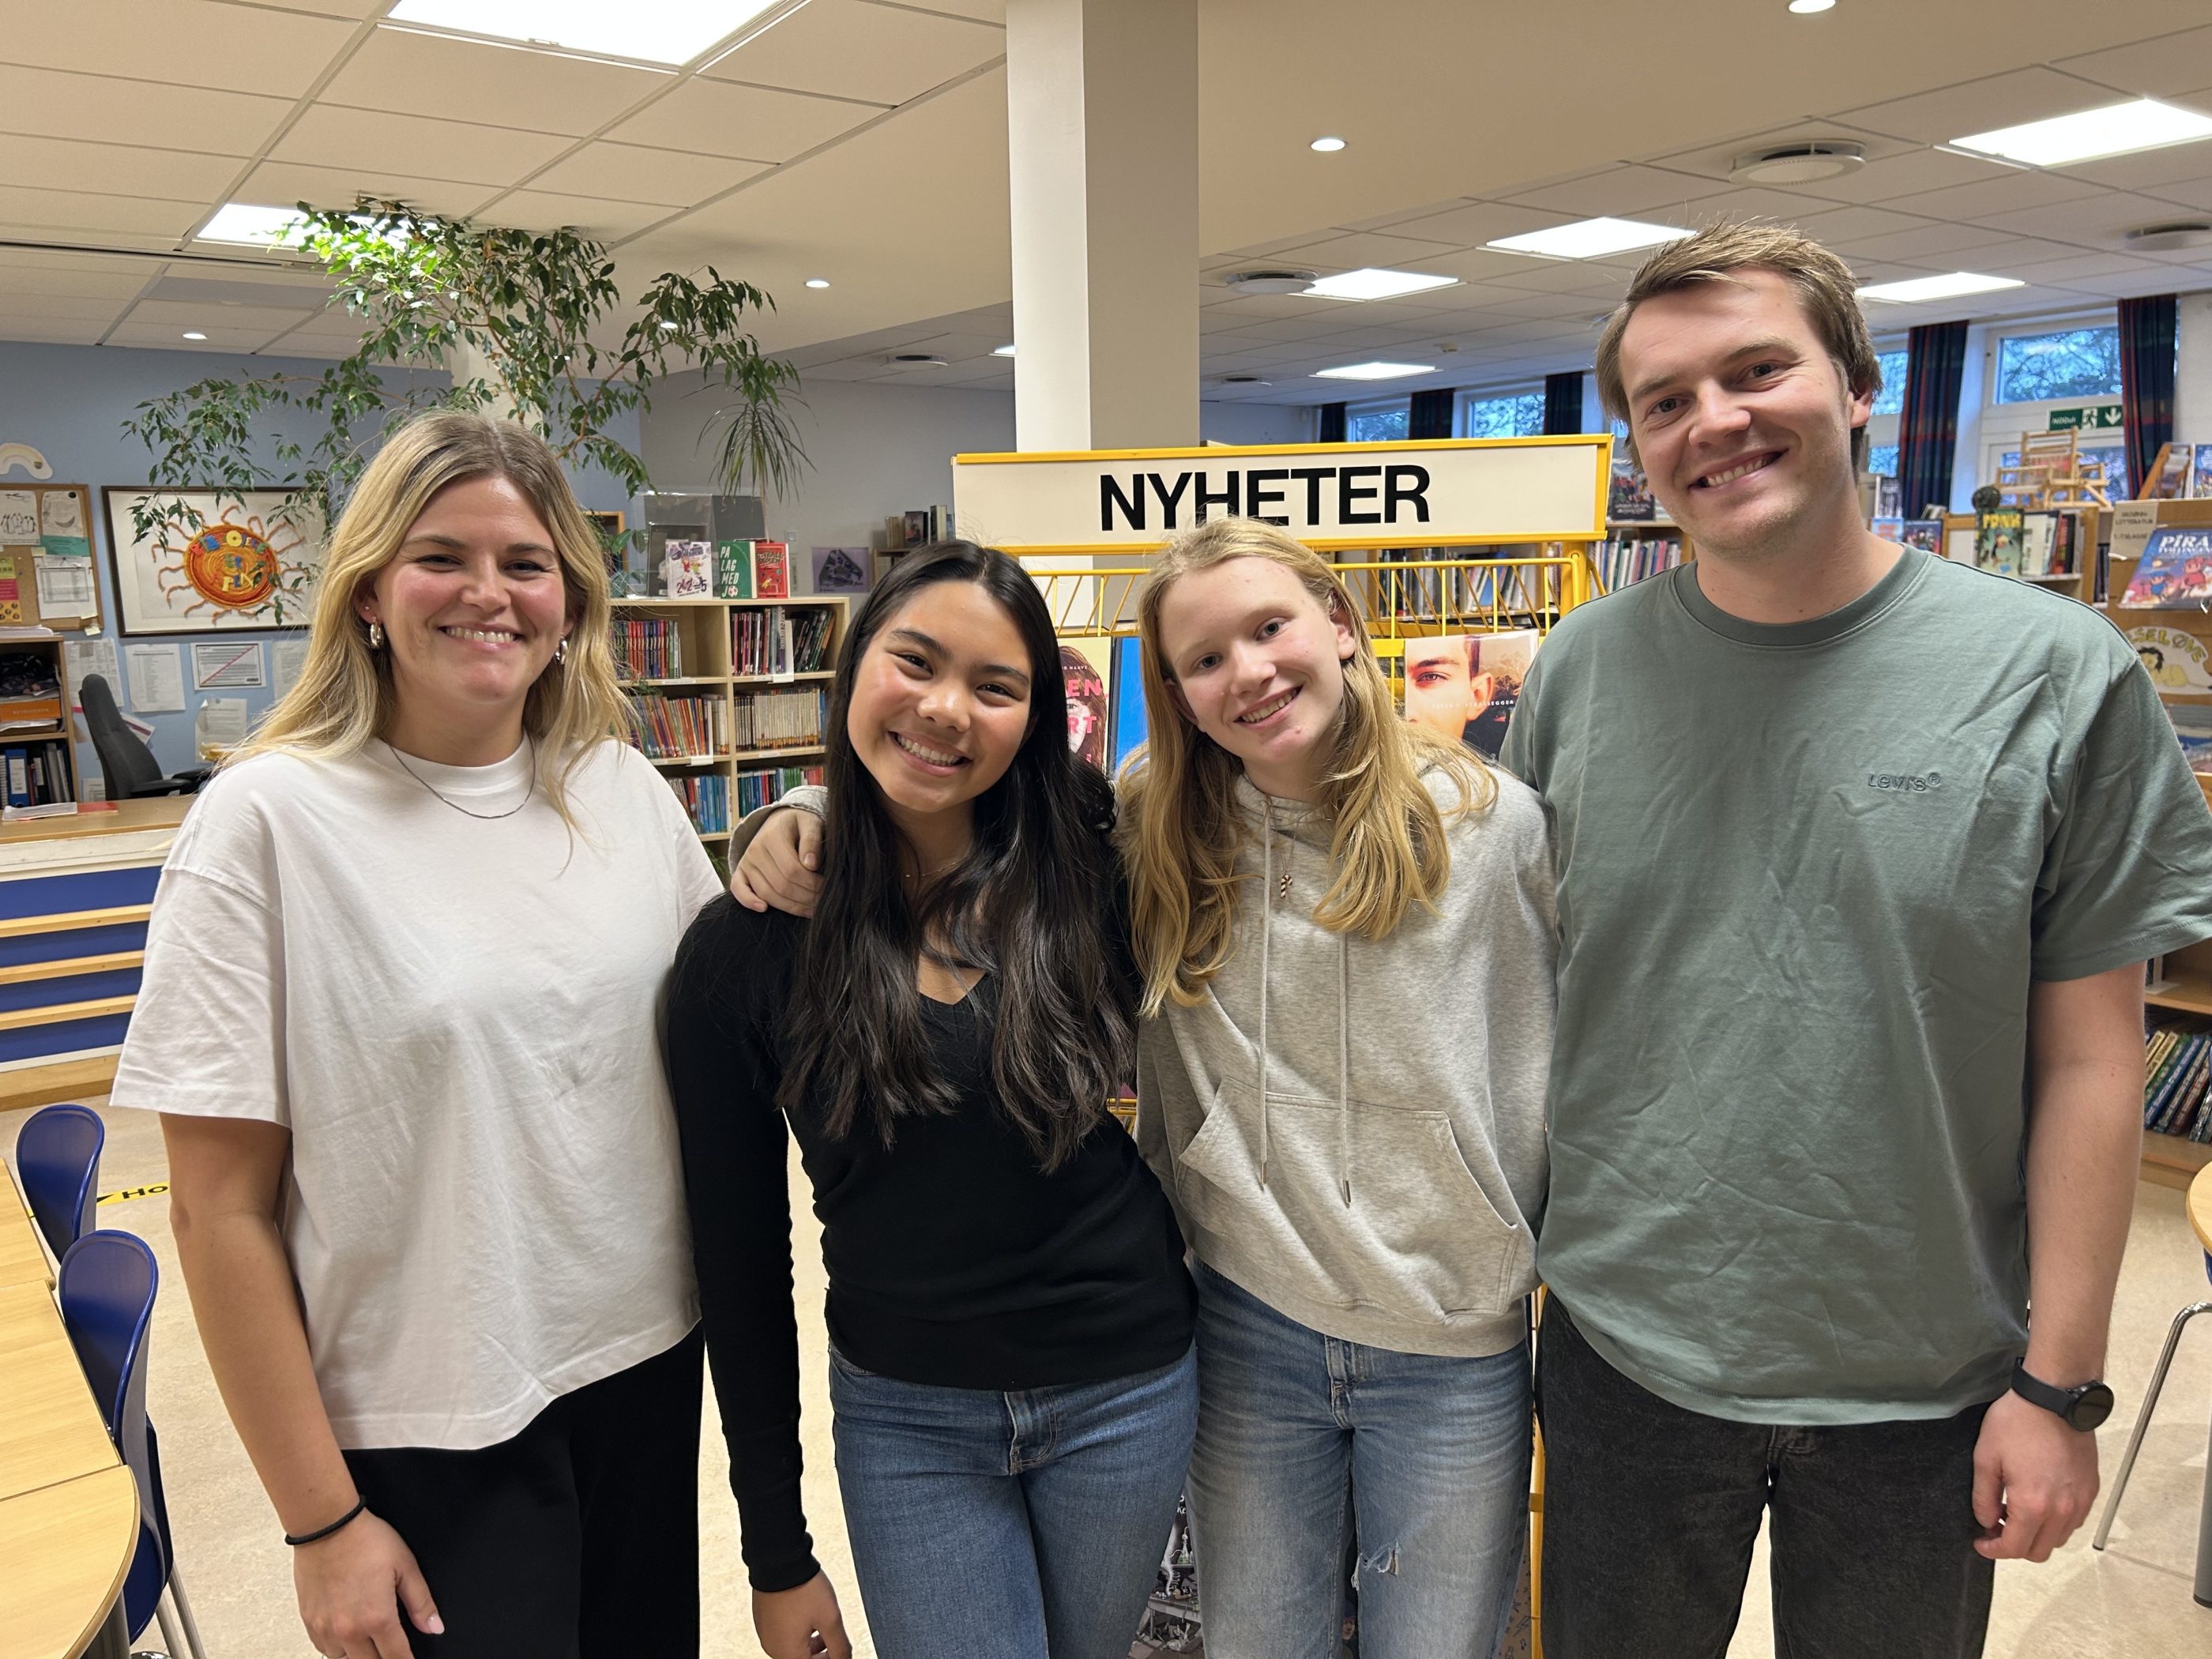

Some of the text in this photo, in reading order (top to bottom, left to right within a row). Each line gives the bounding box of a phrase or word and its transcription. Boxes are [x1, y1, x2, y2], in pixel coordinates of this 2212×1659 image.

[1100, 465, 1431, 531] NYHETER
[2159, 534, 2212, 548] PIRA
[720, 559, 737, 572] LAG
[721, 572, 740, 585] MED
